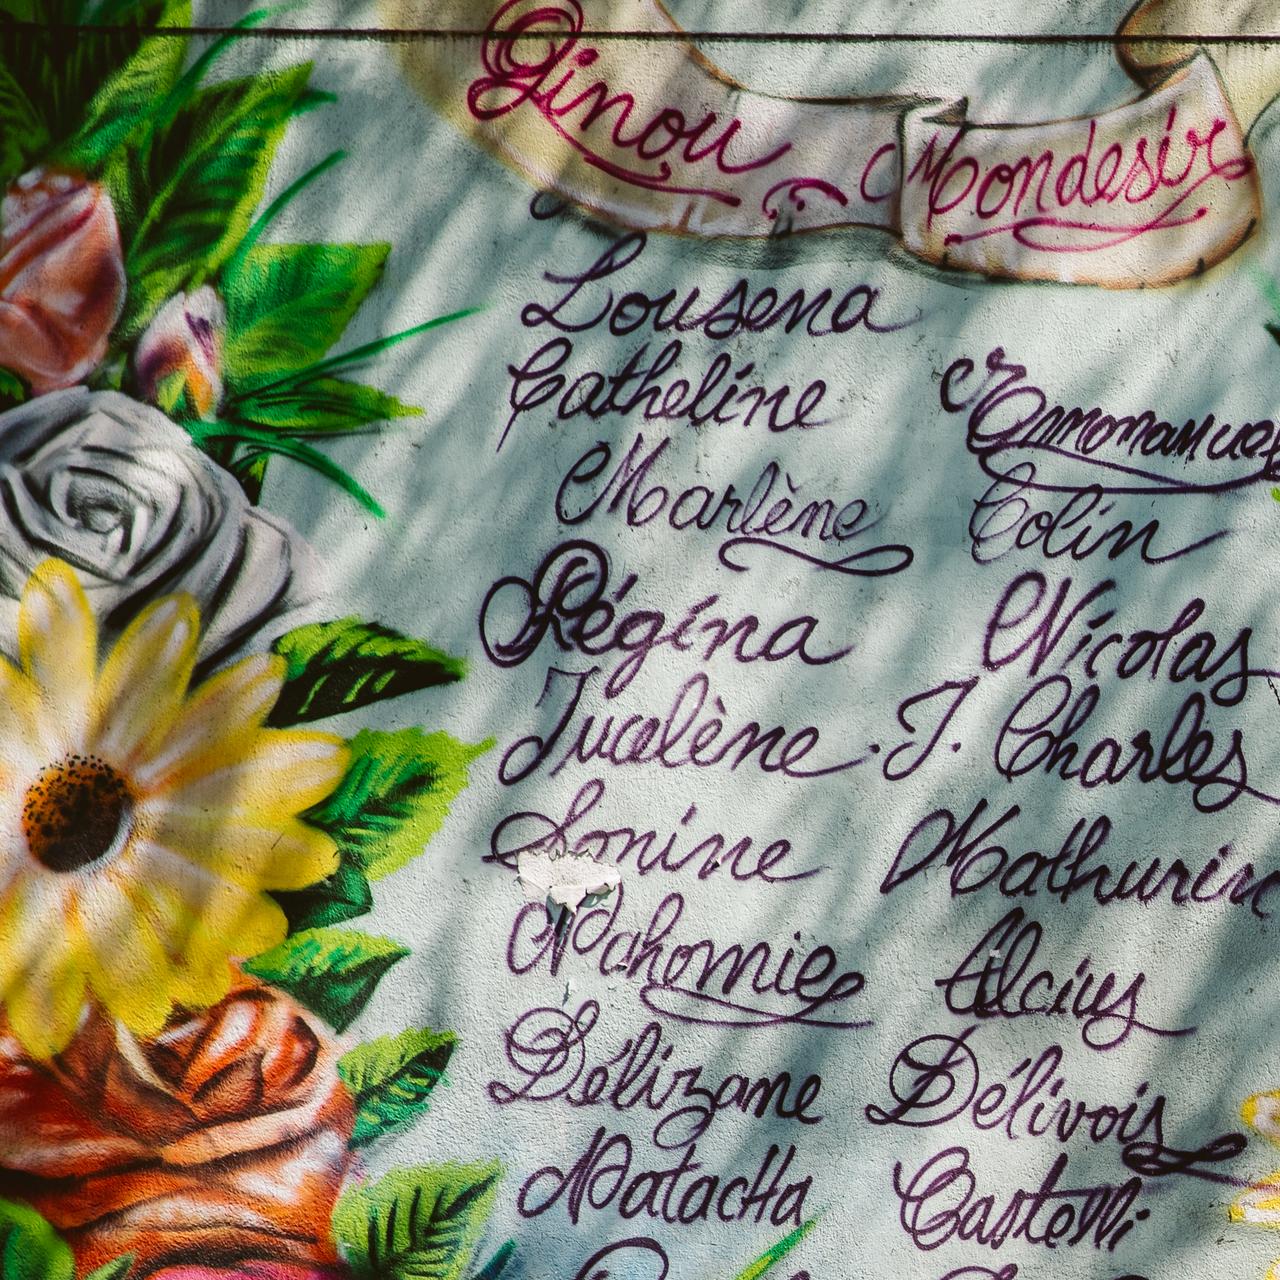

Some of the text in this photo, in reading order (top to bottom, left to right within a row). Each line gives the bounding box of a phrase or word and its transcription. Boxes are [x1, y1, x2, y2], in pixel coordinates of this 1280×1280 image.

[497, 337, 832, 452] Catheline
[555, 433, 1234, 564] Marlène Colin
